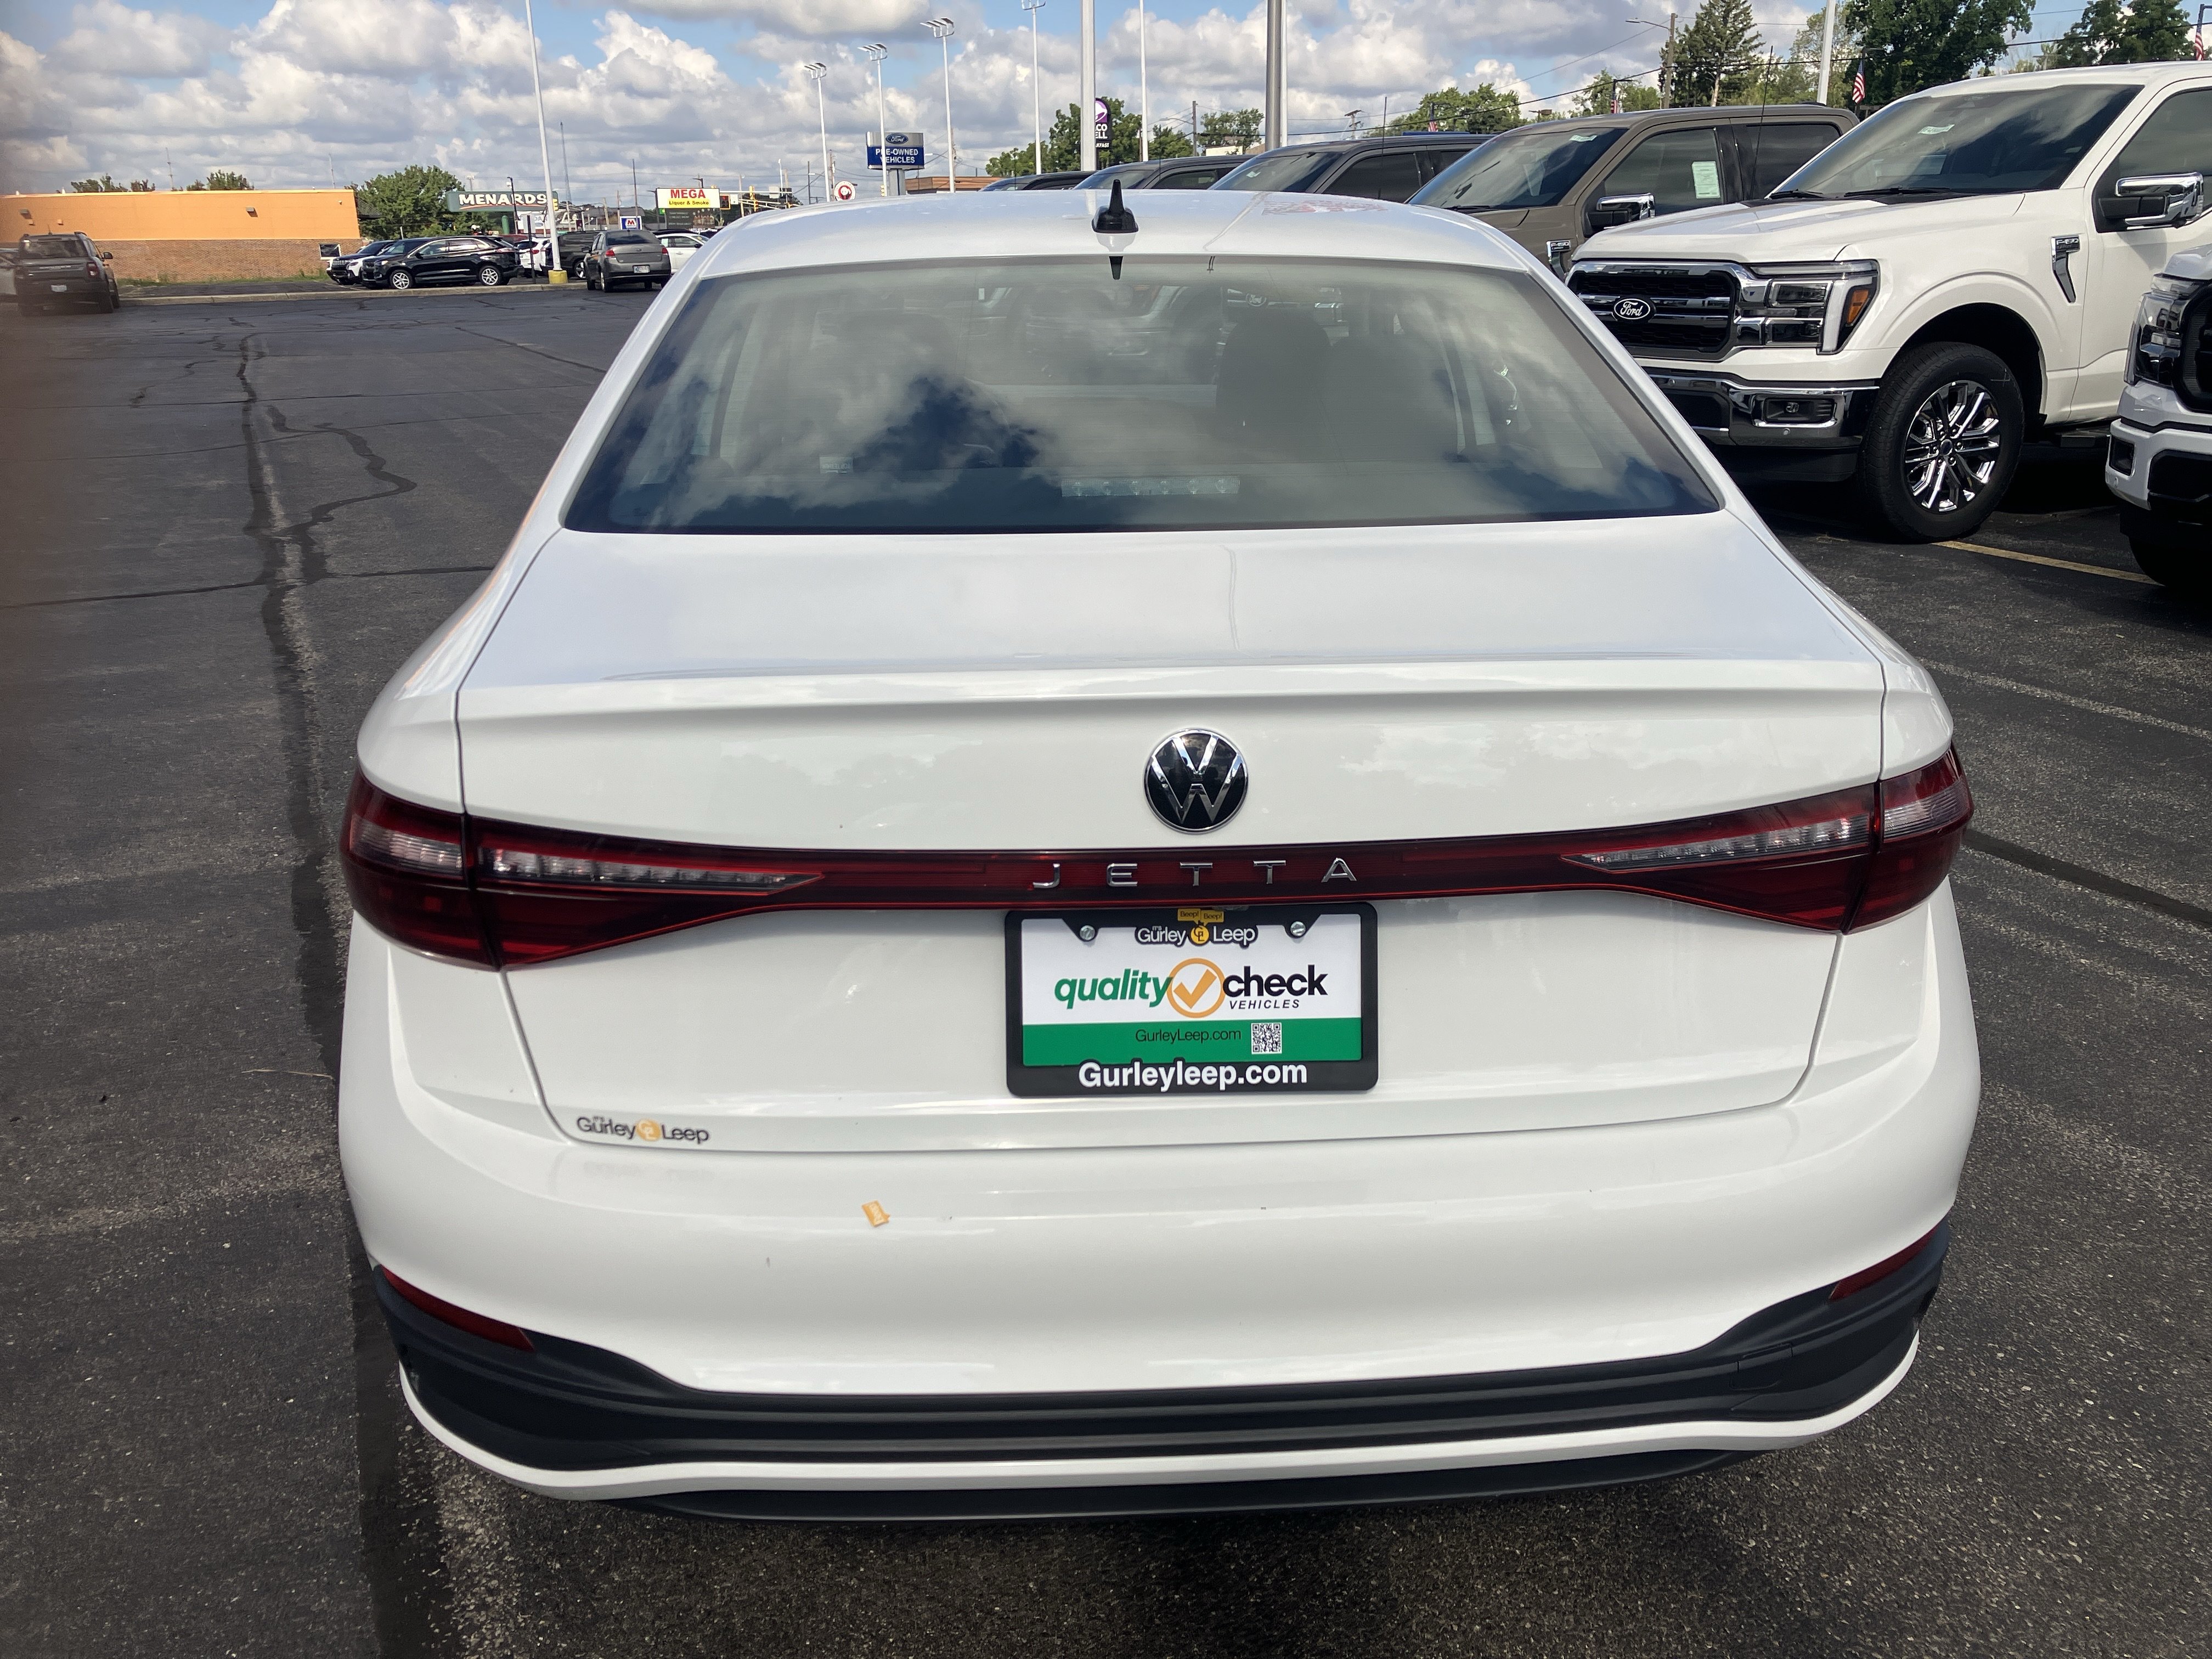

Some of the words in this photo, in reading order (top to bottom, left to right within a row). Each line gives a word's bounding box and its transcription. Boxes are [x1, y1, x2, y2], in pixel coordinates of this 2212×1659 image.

[459, 193, 548, 205] MENARDS
[670, 189, 706, 199] MEGA
[1620, 301, 1644, 317] Ford
[1032, 857, 1357, 888] JETTA
[1180, 909, 1199, 918] Beep!
[1203, 912, 1223, 921] Beep!
[1137, 926, 1186, 946] Gurley
[1213, 926, 1256, 946] Leep
[1054, 968, 1173, 1010] quality
[1222, 964, 1329, 997] check
[1229, 998, 1300, 1010] VEHICLES
[1135, 1028, 1242, 1045] GurleyLeep.com
[1079, 1060, 1307, 1093] Gurleyleep.com
[661, 1124, 709, 1145] Leep
